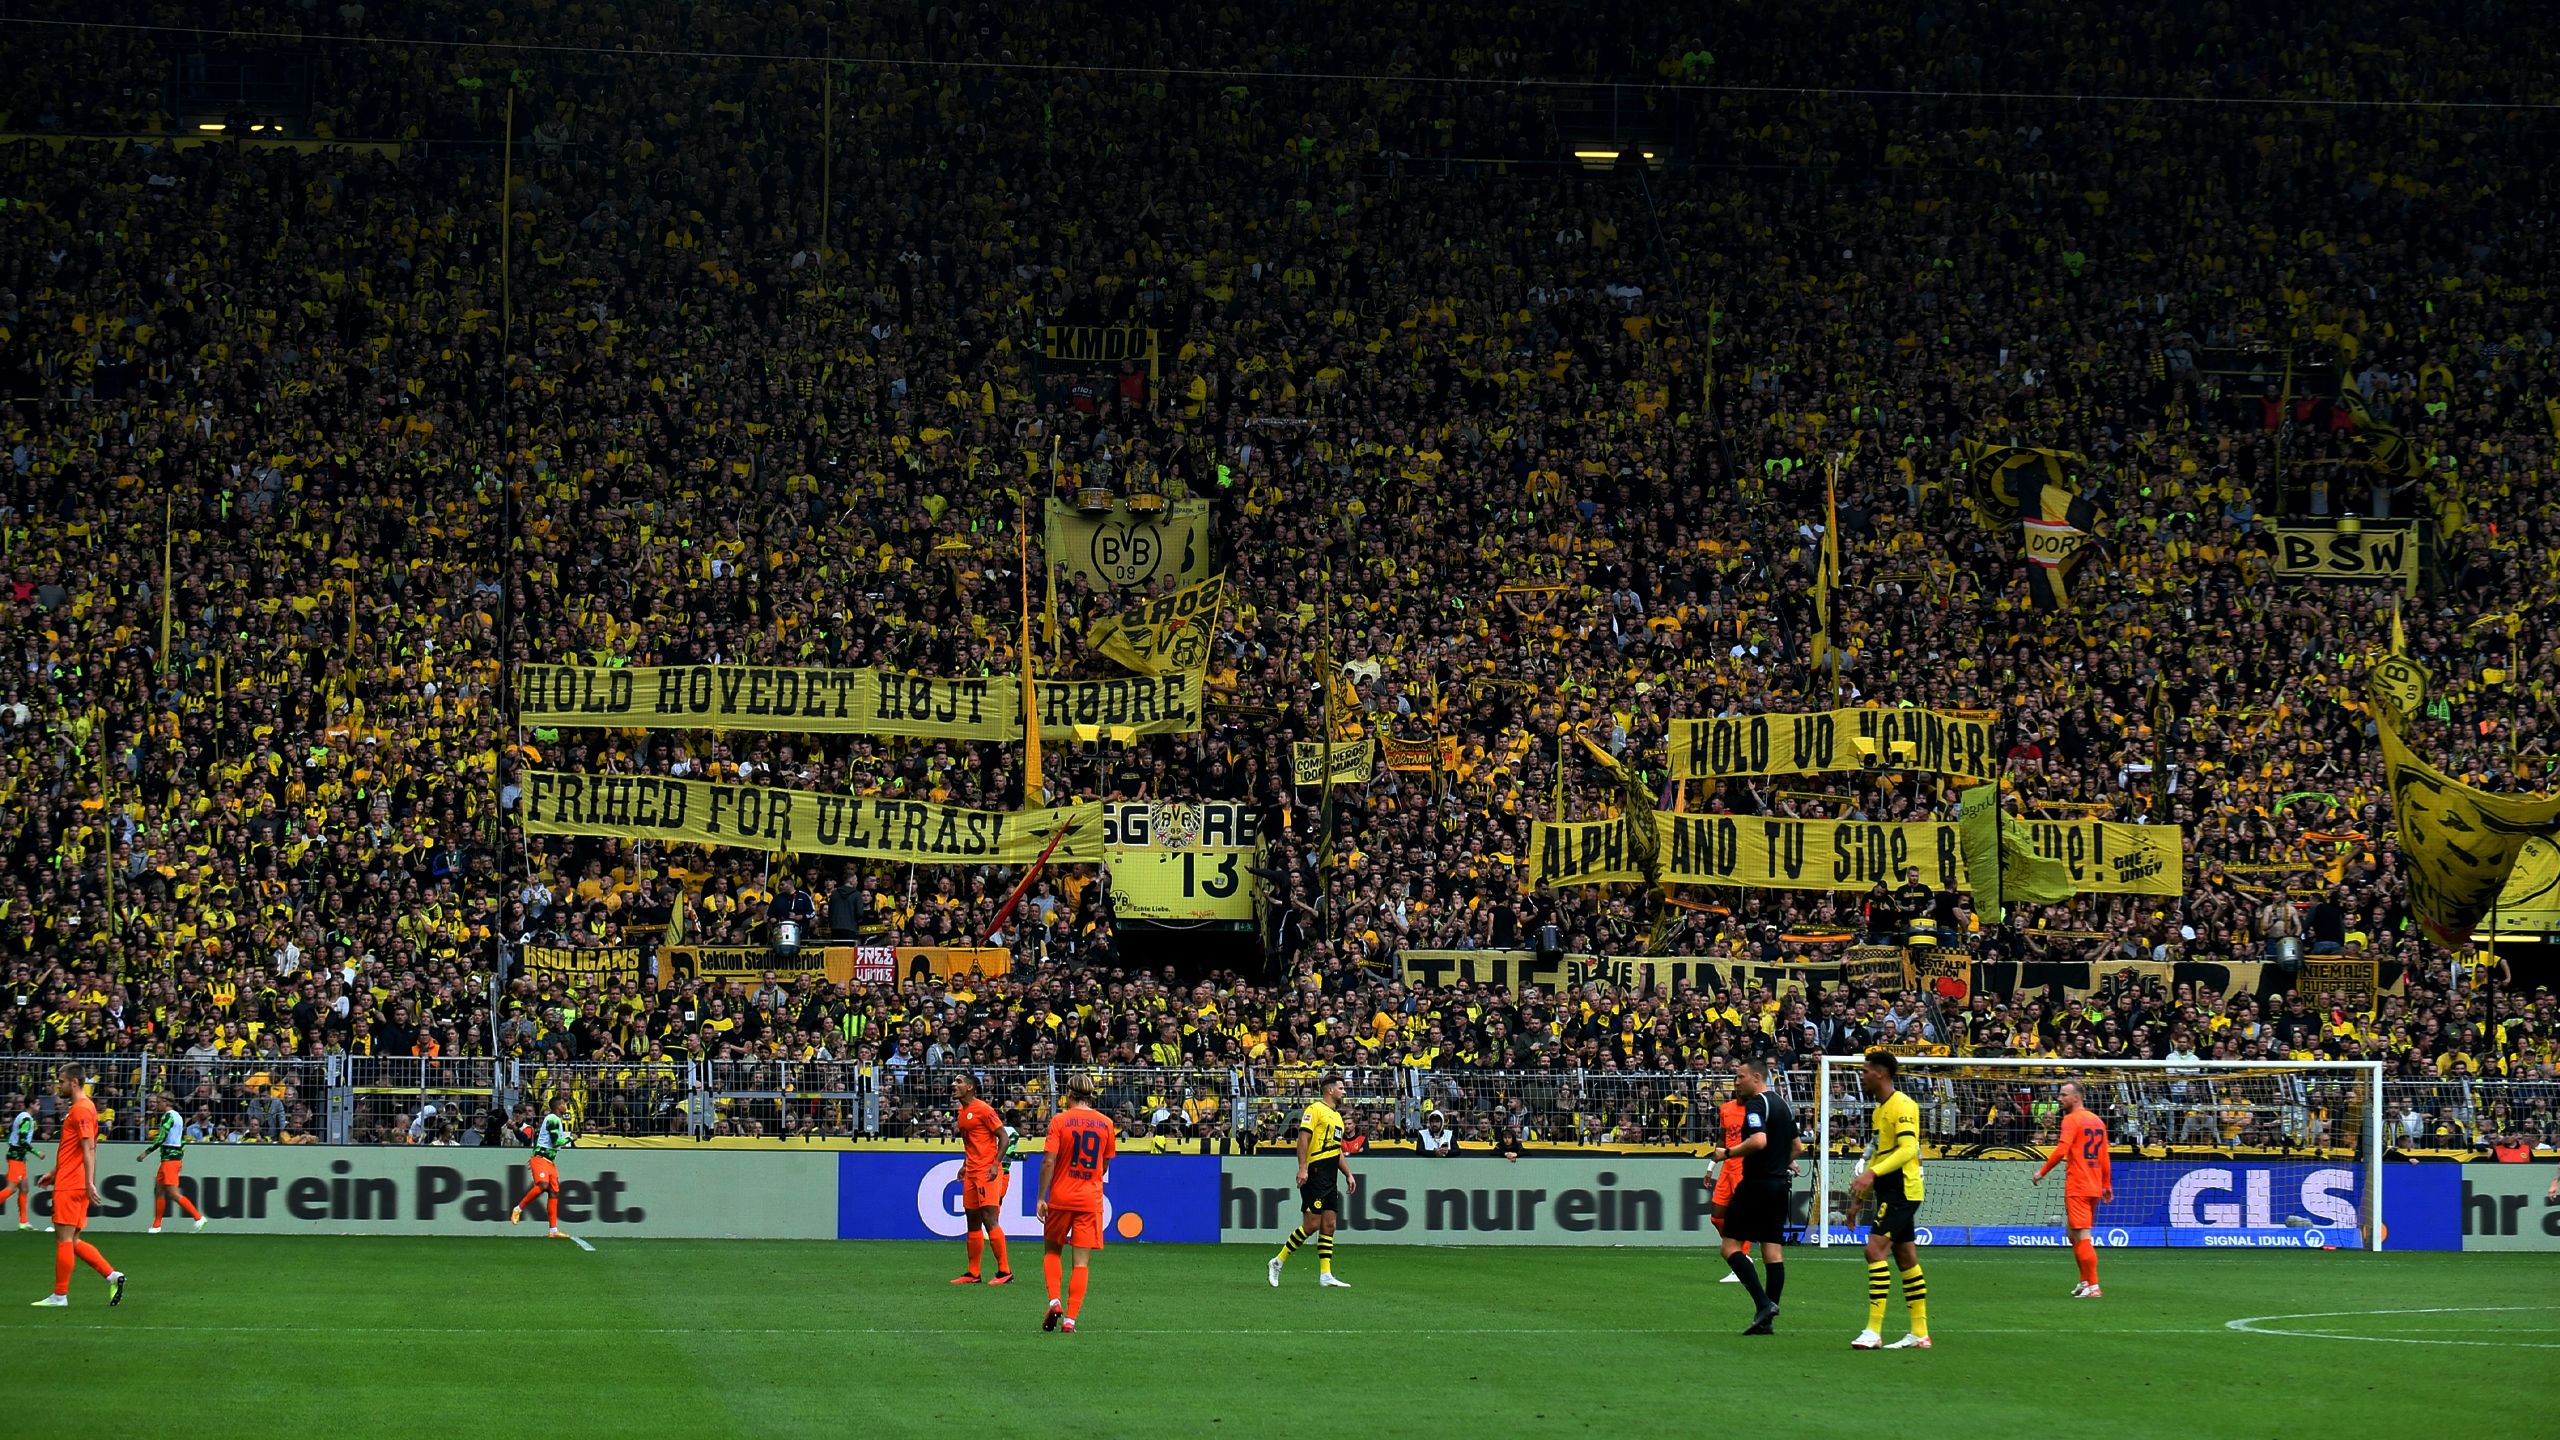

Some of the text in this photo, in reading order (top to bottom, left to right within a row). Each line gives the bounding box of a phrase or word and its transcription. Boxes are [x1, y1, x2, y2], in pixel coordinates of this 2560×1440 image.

[1102, 521, 1150, 566] BVB
[2284, 532, 2404, 572] BSW
[1116, 565, 1136, 580] 09
[521, 665, 634, 713] HOLD
[655, 667, 854, 719] HOVEDET
[877, 672, 988, 724] HØJT
[1690, 716, 1769, 776] HOLD
[528, 773, 1004, 855] FRIHED FOR ULTRAS!
[1671, 816, 1737, 877] AND
[523, 944, 640, 972] HOOLIGANS
[700, 950, 743, 971] Sektion
[856, 947, 894, 965] FREE
[2302, 963, 2373, 979] NIEMALS
[1071, 1130, 1101, 1170] 19
[286, 1159, 397, 1221] ein
[415, 1164, 646, 1224] Paket.
[1221, 1172, 1290, 1230] hr
[1424, 1187, 1548, 1231] nur
[1553, 1172, 1663, 1231] ein
[2168, 1167, 2360, 1229] GLS
[2462, 1179, 2528, 1236] hr
[1810, 1233, 1862, 1245] SGNAL
[2007, 1235, 2059, 1246] SIGNAL
[2204, 1235, 2301, 1247] SIGNAL IDUNA
